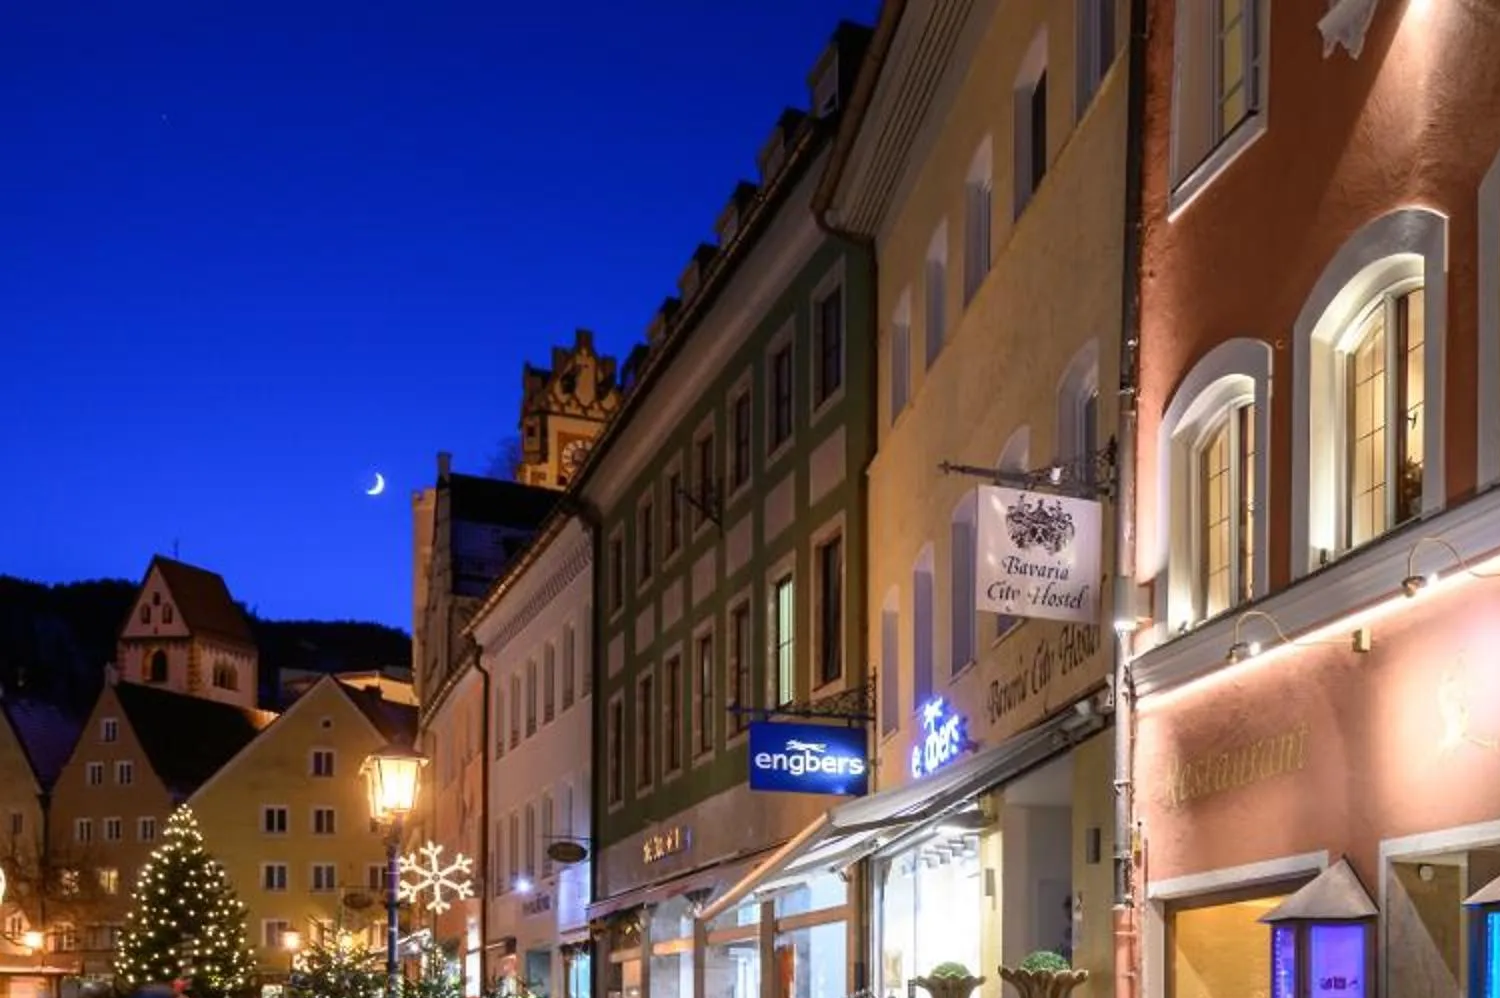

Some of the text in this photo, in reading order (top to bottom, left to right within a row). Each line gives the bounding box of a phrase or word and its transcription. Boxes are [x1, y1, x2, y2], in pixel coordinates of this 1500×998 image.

[1001, 555, 1070, 581] Bavaria
[987, 581, 1089, 612] City Hostel
[754, 749, 865, 776] engbers
[1163, 720, 1311, 808] Restaurant
